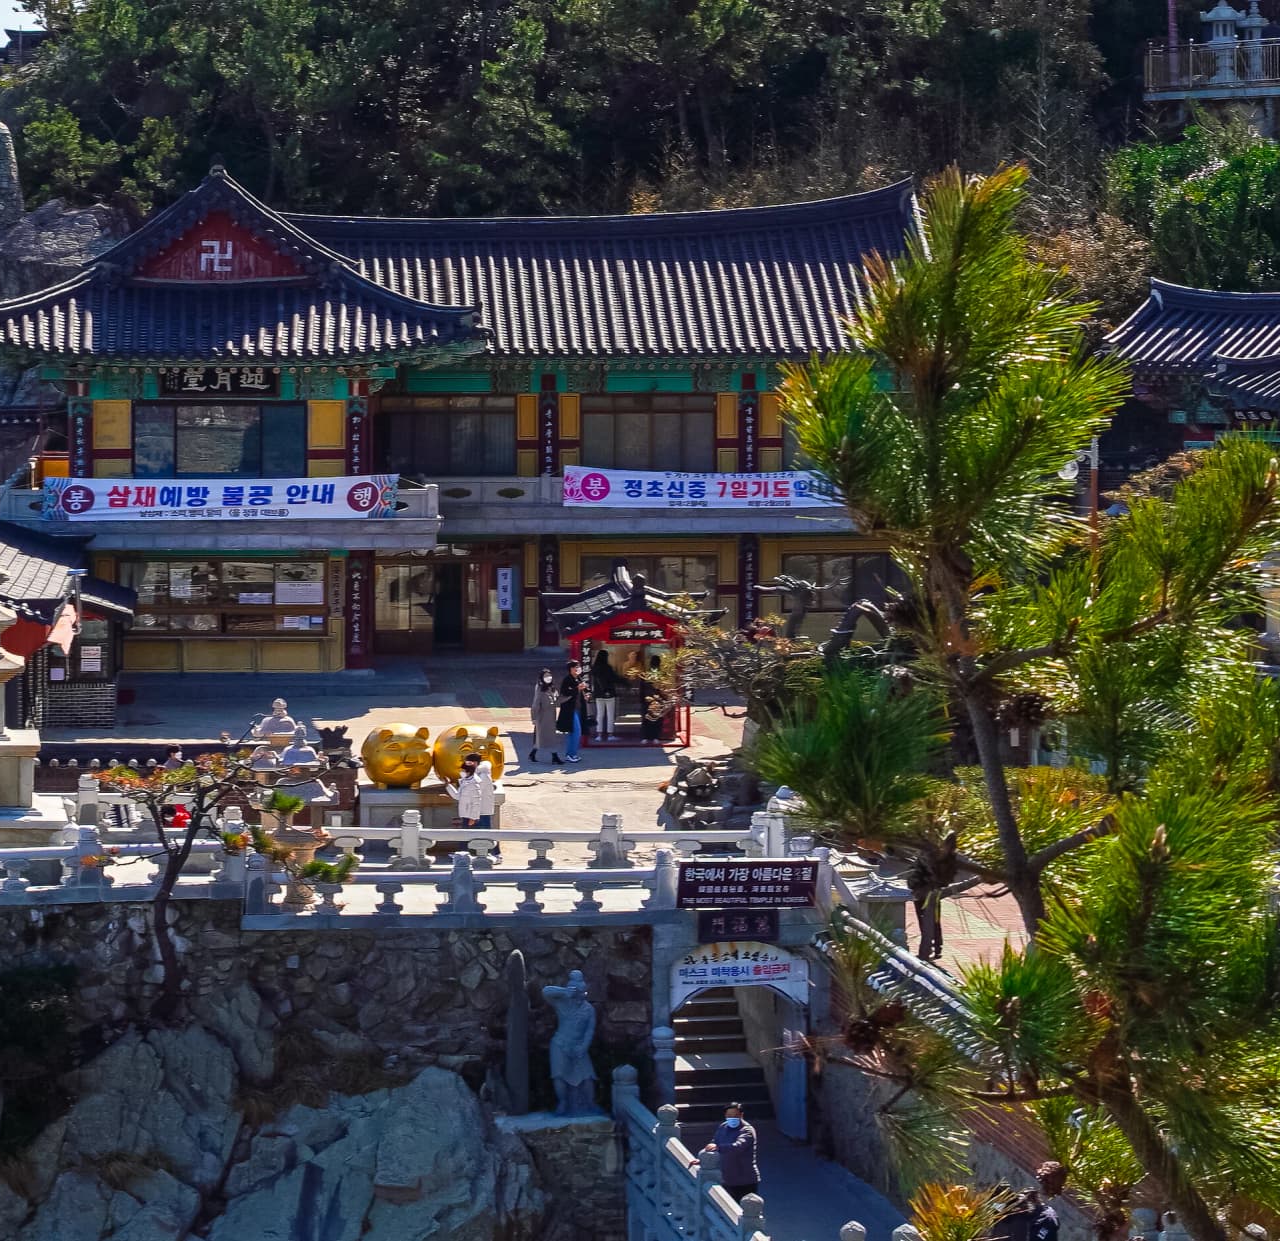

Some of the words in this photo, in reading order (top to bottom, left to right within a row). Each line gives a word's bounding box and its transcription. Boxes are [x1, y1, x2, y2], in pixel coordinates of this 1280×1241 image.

[107, 485, 210, 507] 삼재예방
[222, 486, 273, 506] 불공
[286, 483, 335, 504] 안내
[354, 487, 372, 507] 행
[585, 477, 606, 497] 봉
[624, 479, 706, 499] 정초신중
[66, 490, 90, 511] 봉
[685, 867, 725, 881] 한국에서
[728, 867, 749, 881] 가장
[752, 867, 792, 881] 아름다운
[679, 966, 708, 977] 마스크
